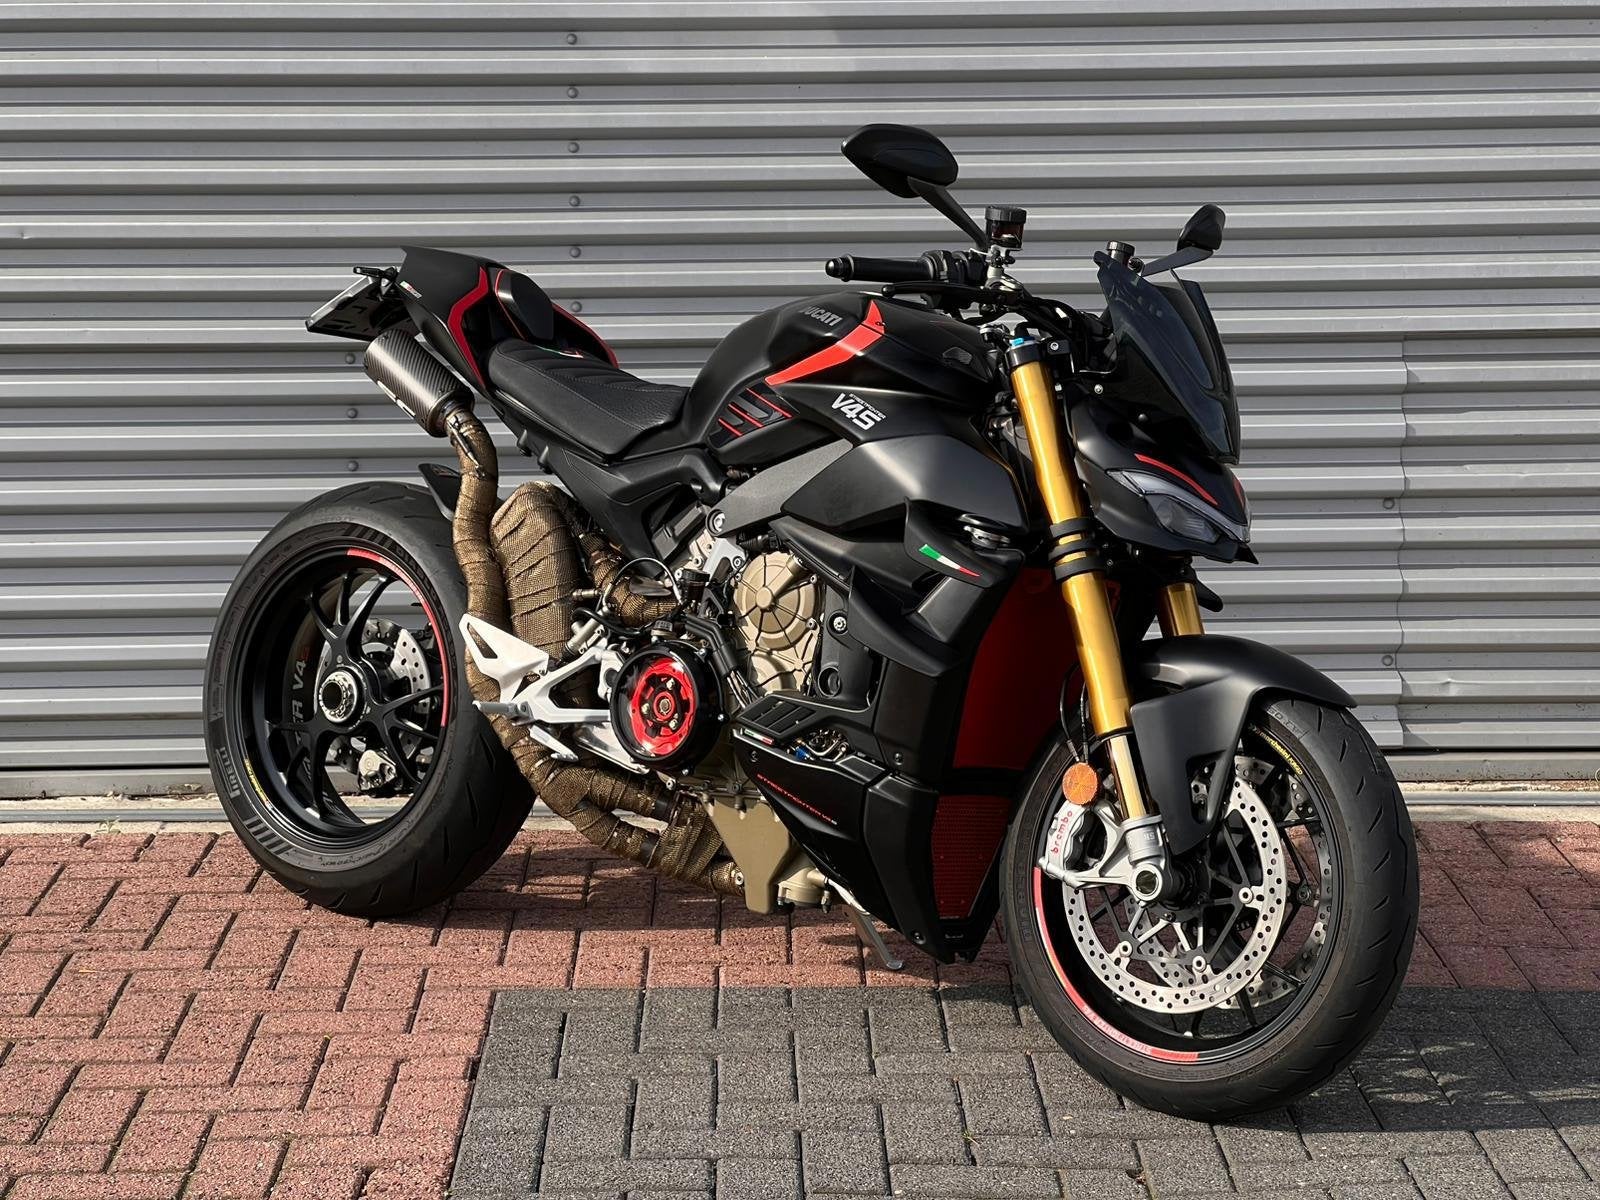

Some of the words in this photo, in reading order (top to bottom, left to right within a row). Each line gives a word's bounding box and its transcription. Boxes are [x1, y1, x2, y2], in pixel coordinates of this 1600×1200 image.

[831, 392, 881, 430] V4S
[216, 746, 241, 799] PIRELLI
[1050, 810, 1074, 855] brembo
